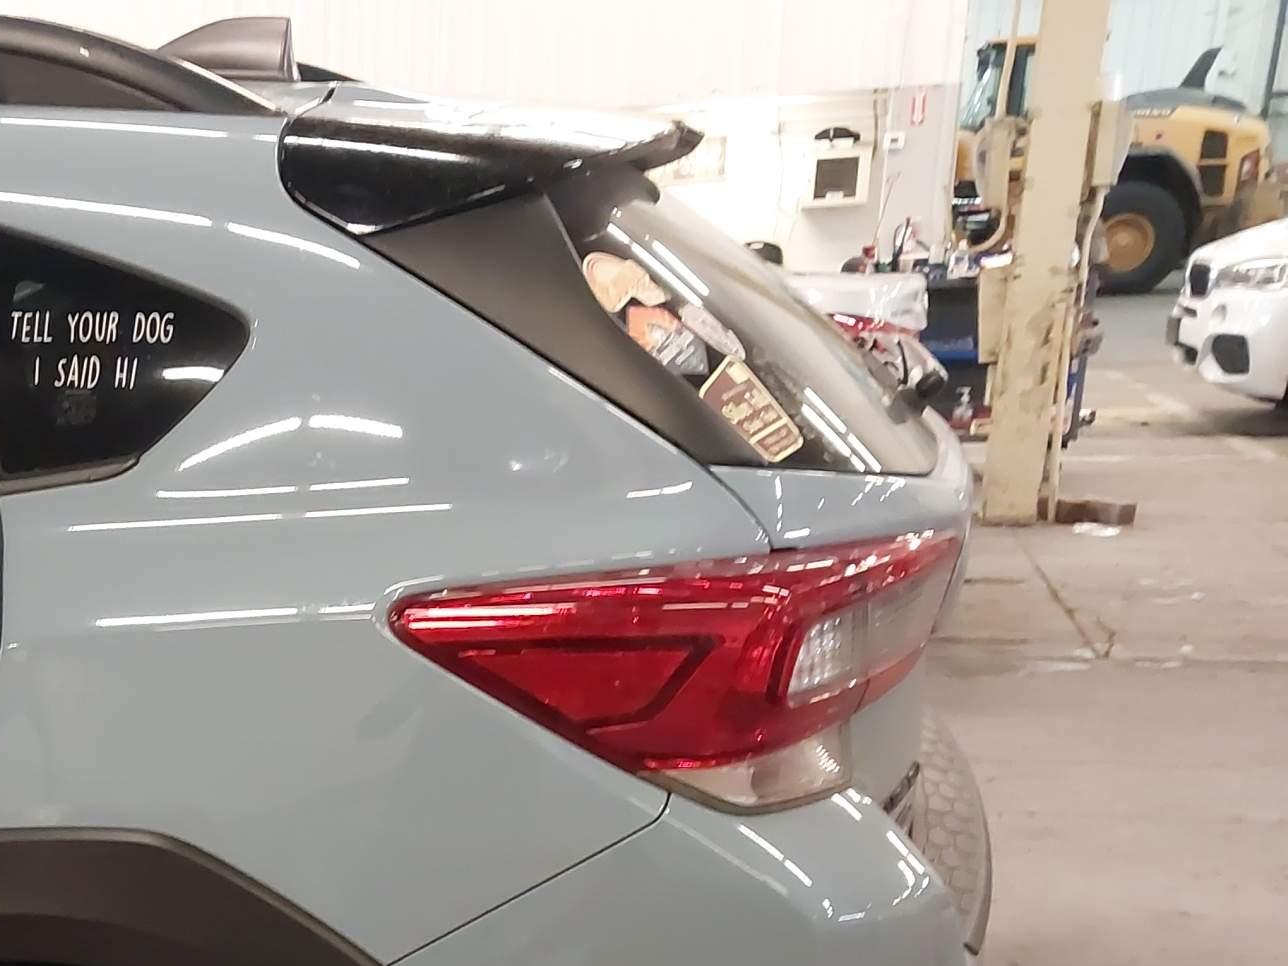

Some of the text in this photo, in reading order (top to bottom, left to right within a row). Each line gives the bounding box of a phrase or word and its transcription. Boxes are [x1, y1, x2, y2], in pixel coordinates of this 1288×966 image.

[10, 310, 175, 345] TELL YOUR DOG
[33, 354, 138, 390] I SAID HI
